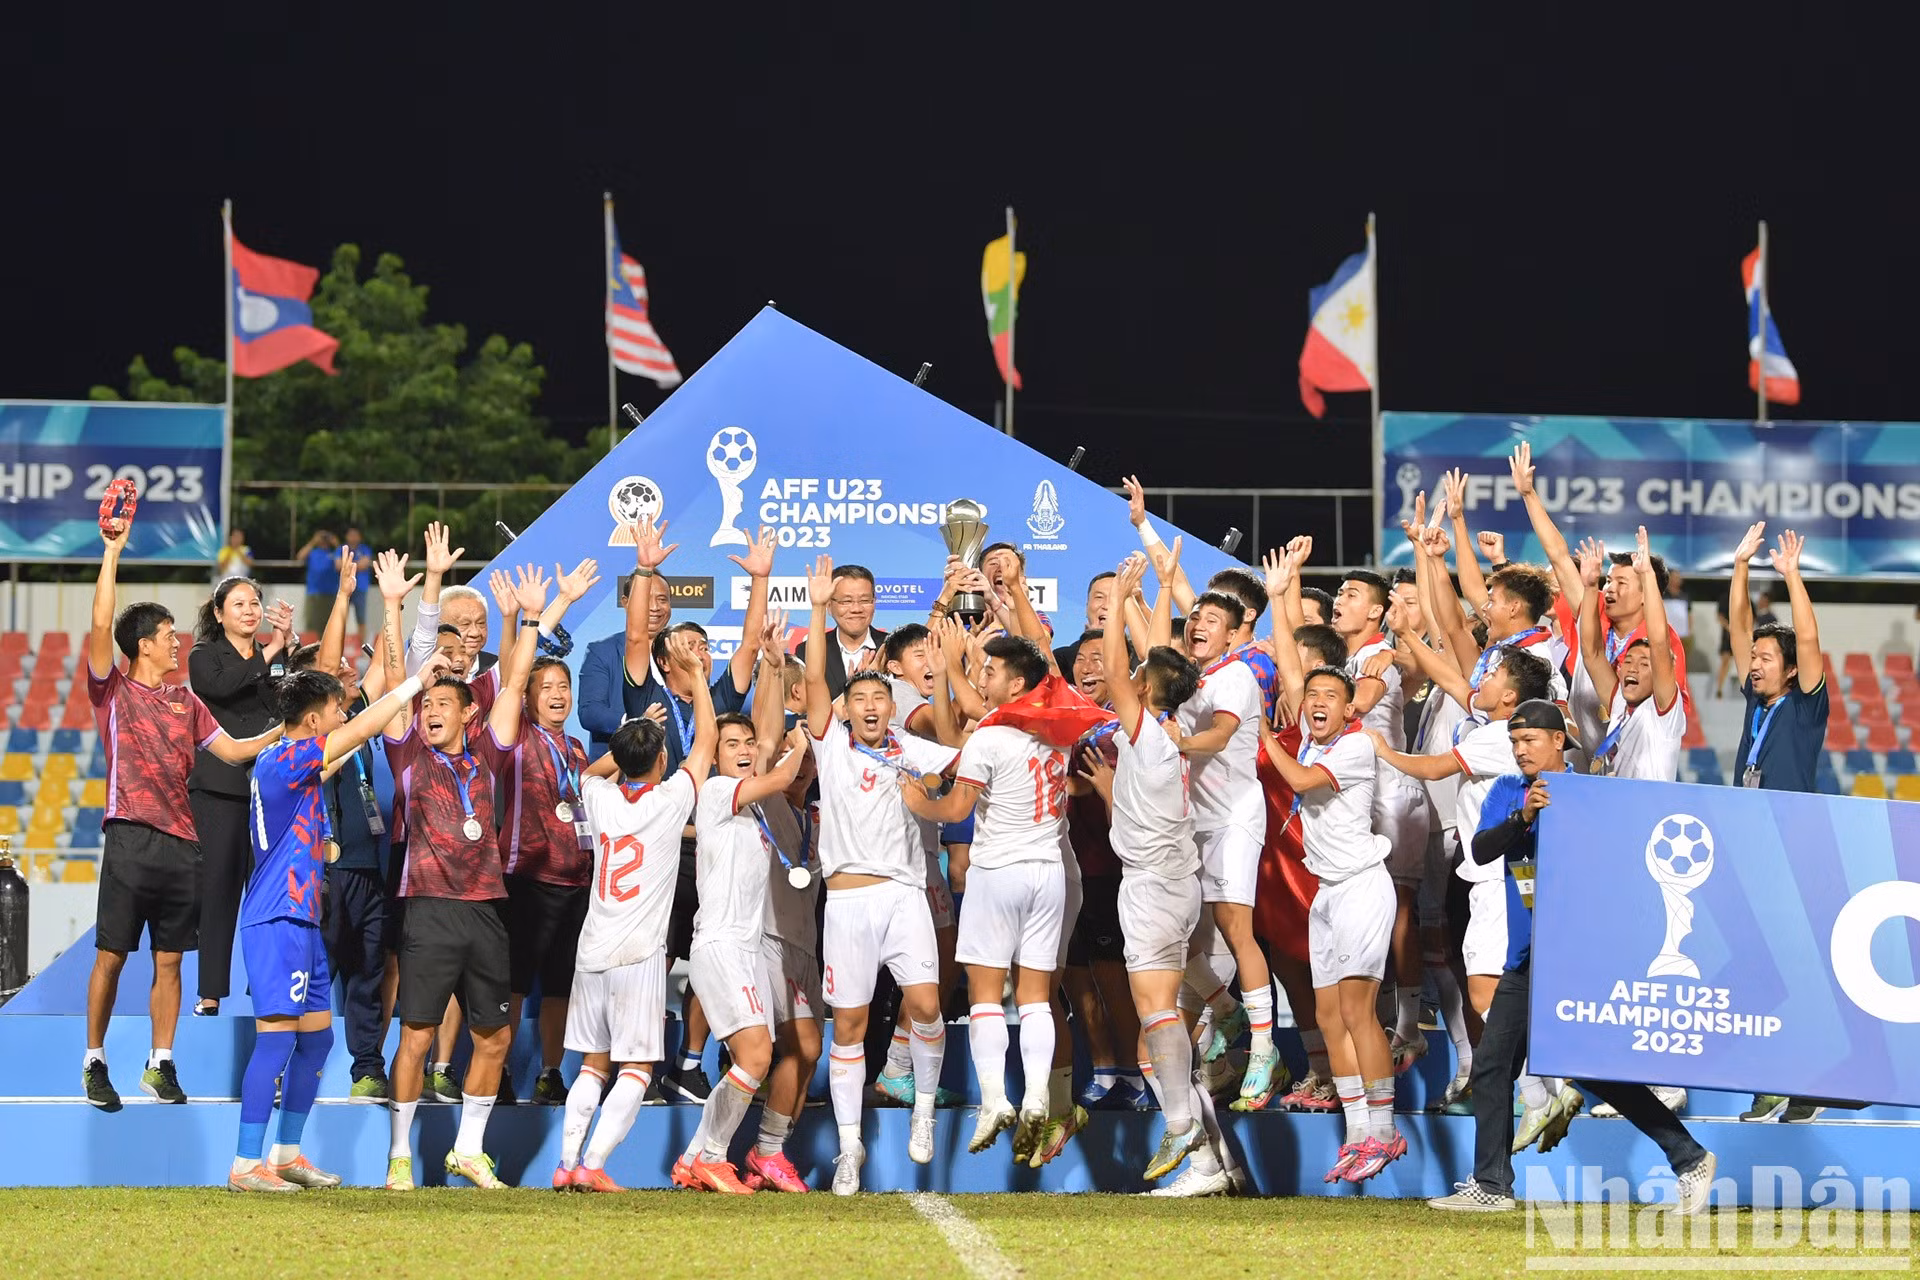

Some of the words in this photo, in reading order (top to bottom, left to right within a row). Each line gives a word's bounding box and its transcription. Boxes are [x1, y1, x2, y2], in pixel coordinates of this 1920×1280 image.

[85, 464, 203, 502] 2023
[760, 478, 819, 500] AFF
[827, 479, 882, 500] U23
[1536, 477, 1624, 514] U23
[1638, 479, 1920, 520] CHAMPIONS
[875, 584, 924, 594] OVOTEL
[600, 832, 643, 902] 12
[290, 970, 308, 1003] 21
[825, 965, 835, 995] 9
[1609, 980, 1667, 1004] AFF
[1675, 985, 1730, 1010] U23
[1555, 999, 1782, 1038] CHAMPIONSHIP
[1632, 1030, 1704, 1056] 2023
